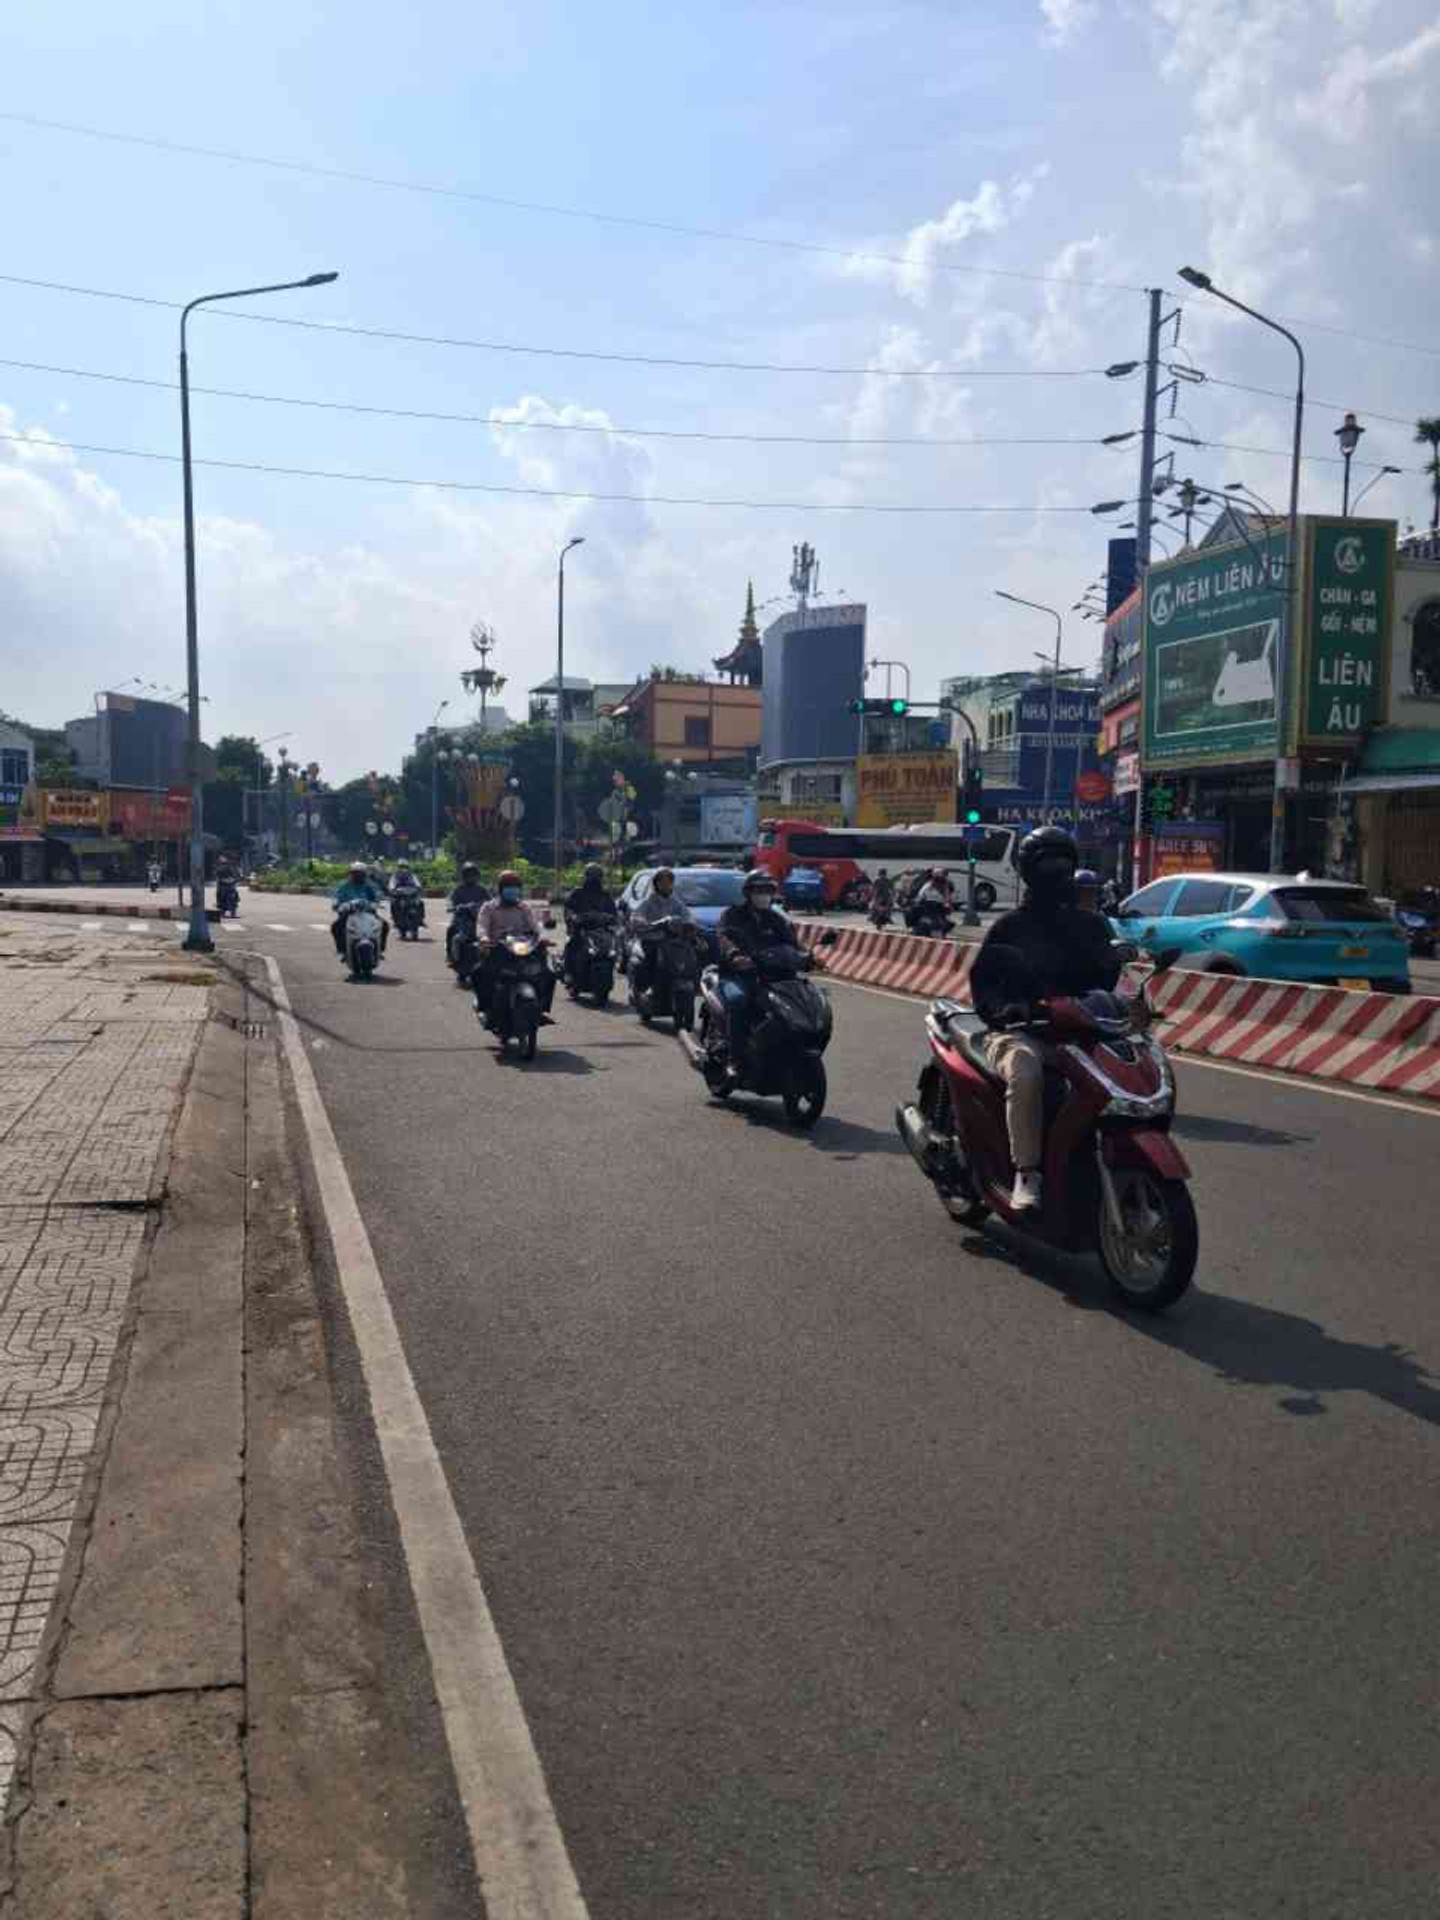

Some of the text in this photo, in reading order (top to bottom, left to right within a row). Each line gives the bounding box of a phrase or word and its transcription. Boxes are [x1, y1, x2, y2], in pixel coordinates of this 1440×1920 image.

[1215, 562, 1254, 596] LIÊN
[1318, 652, 1373, 686] LIÊN
[1326, 697, 1361, 730] ÂU
